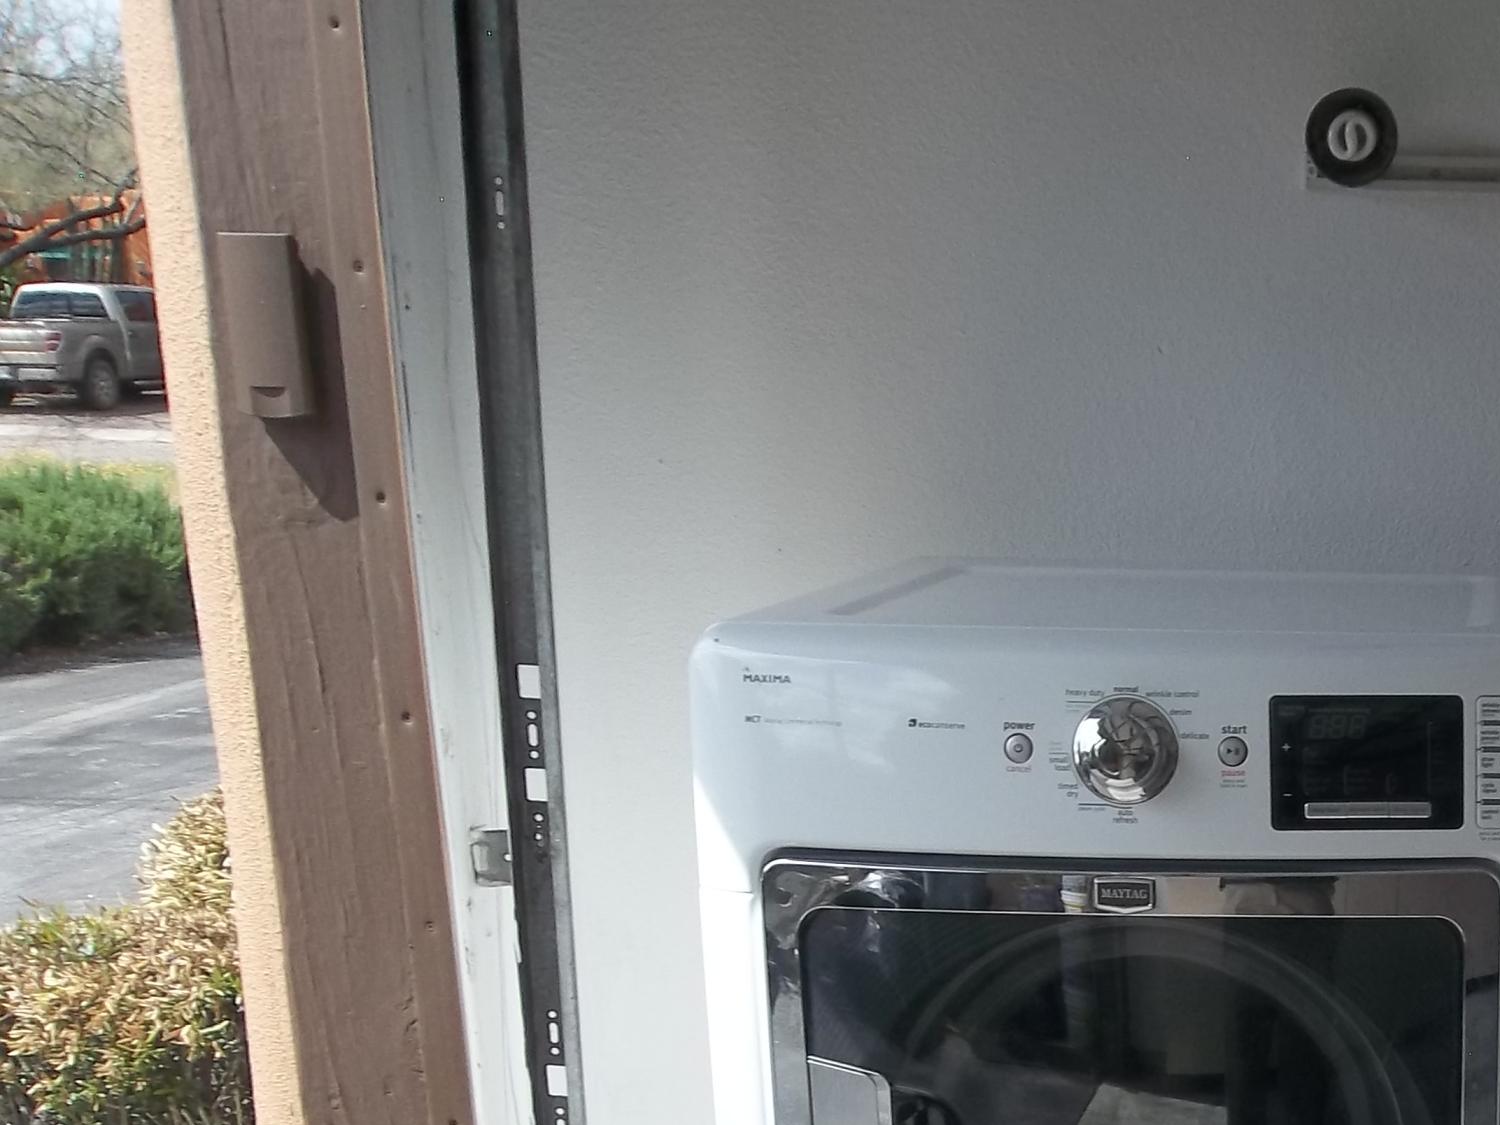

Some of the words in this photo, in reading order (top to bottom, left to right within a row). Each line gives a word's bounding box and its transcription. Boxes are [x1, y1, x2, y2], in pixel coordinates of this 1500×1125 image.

[743, 674, 792, 684] MAXIMA
[1003, 721, 1036, 732] power
[1221, 725, 1247, 735] start
[1006, 765, 1032, 773] cancel
[1101, 888, 1148, 899] MAYTAG
